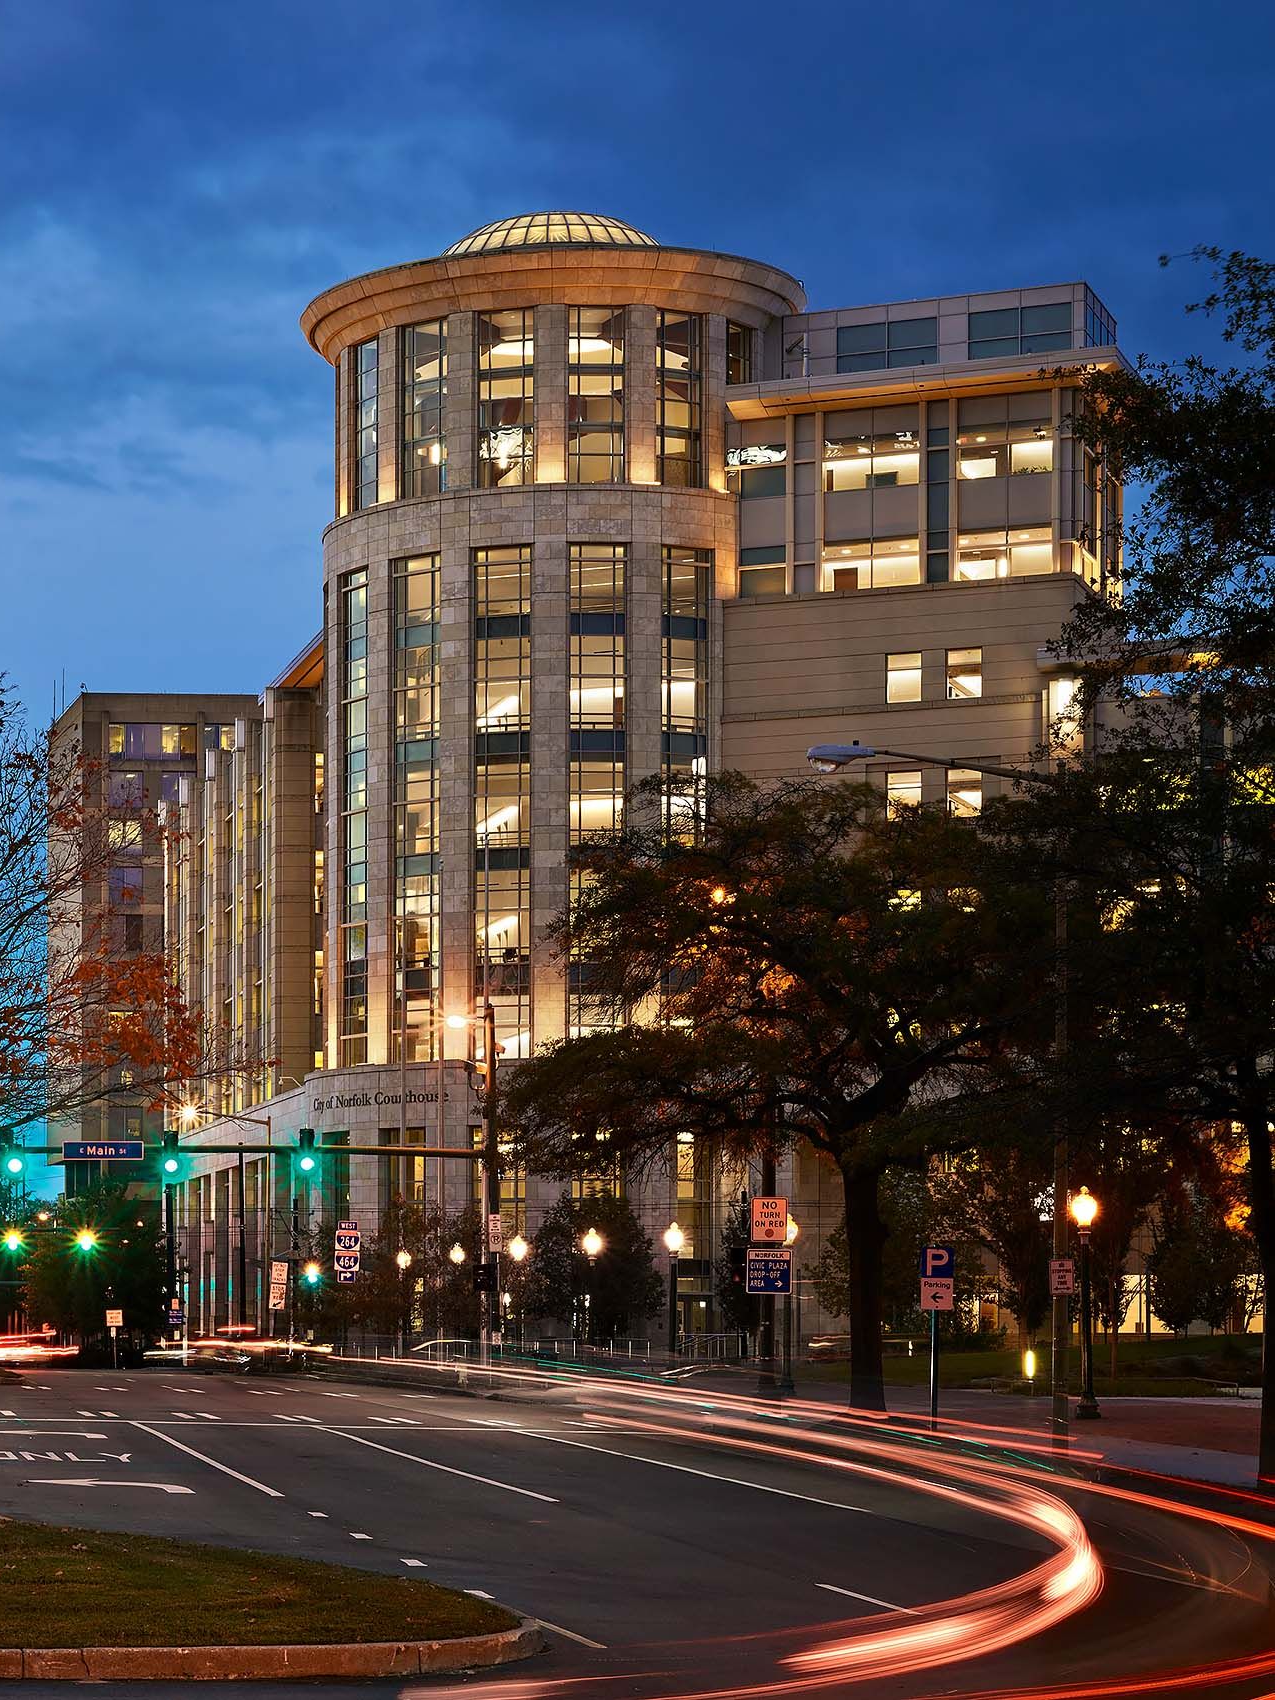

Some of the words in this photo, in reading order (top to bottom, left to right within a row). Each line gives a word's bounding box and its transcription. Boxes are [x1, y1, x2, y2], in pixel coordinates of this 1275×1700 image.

[325, 1095, 334, 1109] of
[335, 1093, 372, 1108] Norfolk
[86, 1145, 116, 1156] Main
[762, 1201, 778, 1210] NO
[759, 1211, 781, 1219] TURN
[754, 1220, 766, 1228] ON
[768, 1220, 785, 1228] RED
[340, 1236, 355, 1247] 264
[339, 1256, 355, 1268] 464
[749, 1262, 765, 1270] CIVIC
[768, 1262, 788, 1270] PLAZA
[926, 1248, 949, 1276] P
[749, 1271, 781, 1279] DROP-OFF
[749, 1280, 765, 1288] AREA
[923, 1281, 951, 1290] Parking
